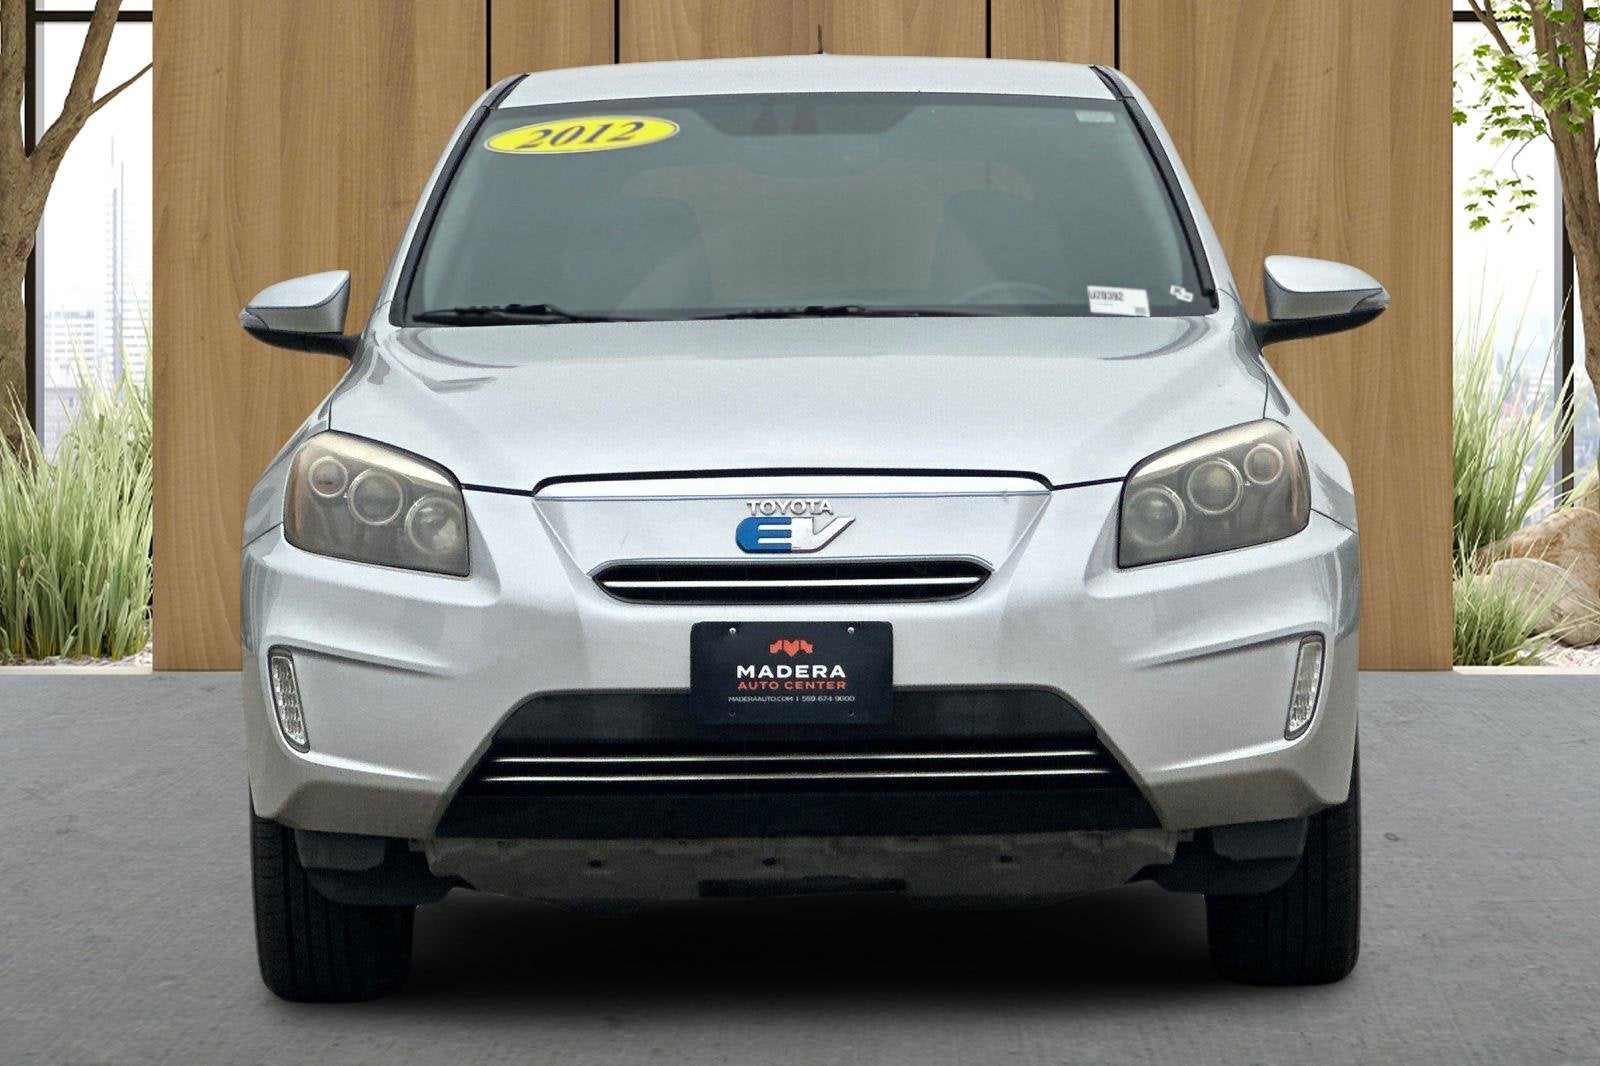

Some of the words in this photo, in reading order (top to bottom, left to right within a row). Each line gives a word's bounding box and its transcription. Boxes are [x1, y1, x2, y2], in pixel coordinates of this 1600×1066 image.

[514, 121, 645, 150] 2012
[747, 499, 834, 516] TOYOTA
[735, 516, 856, 554] EV
[736, 664, 846, 679] MADERA
[737, 681, 779, 690] AUTO
[784, 681, 846, 690] CENTER
